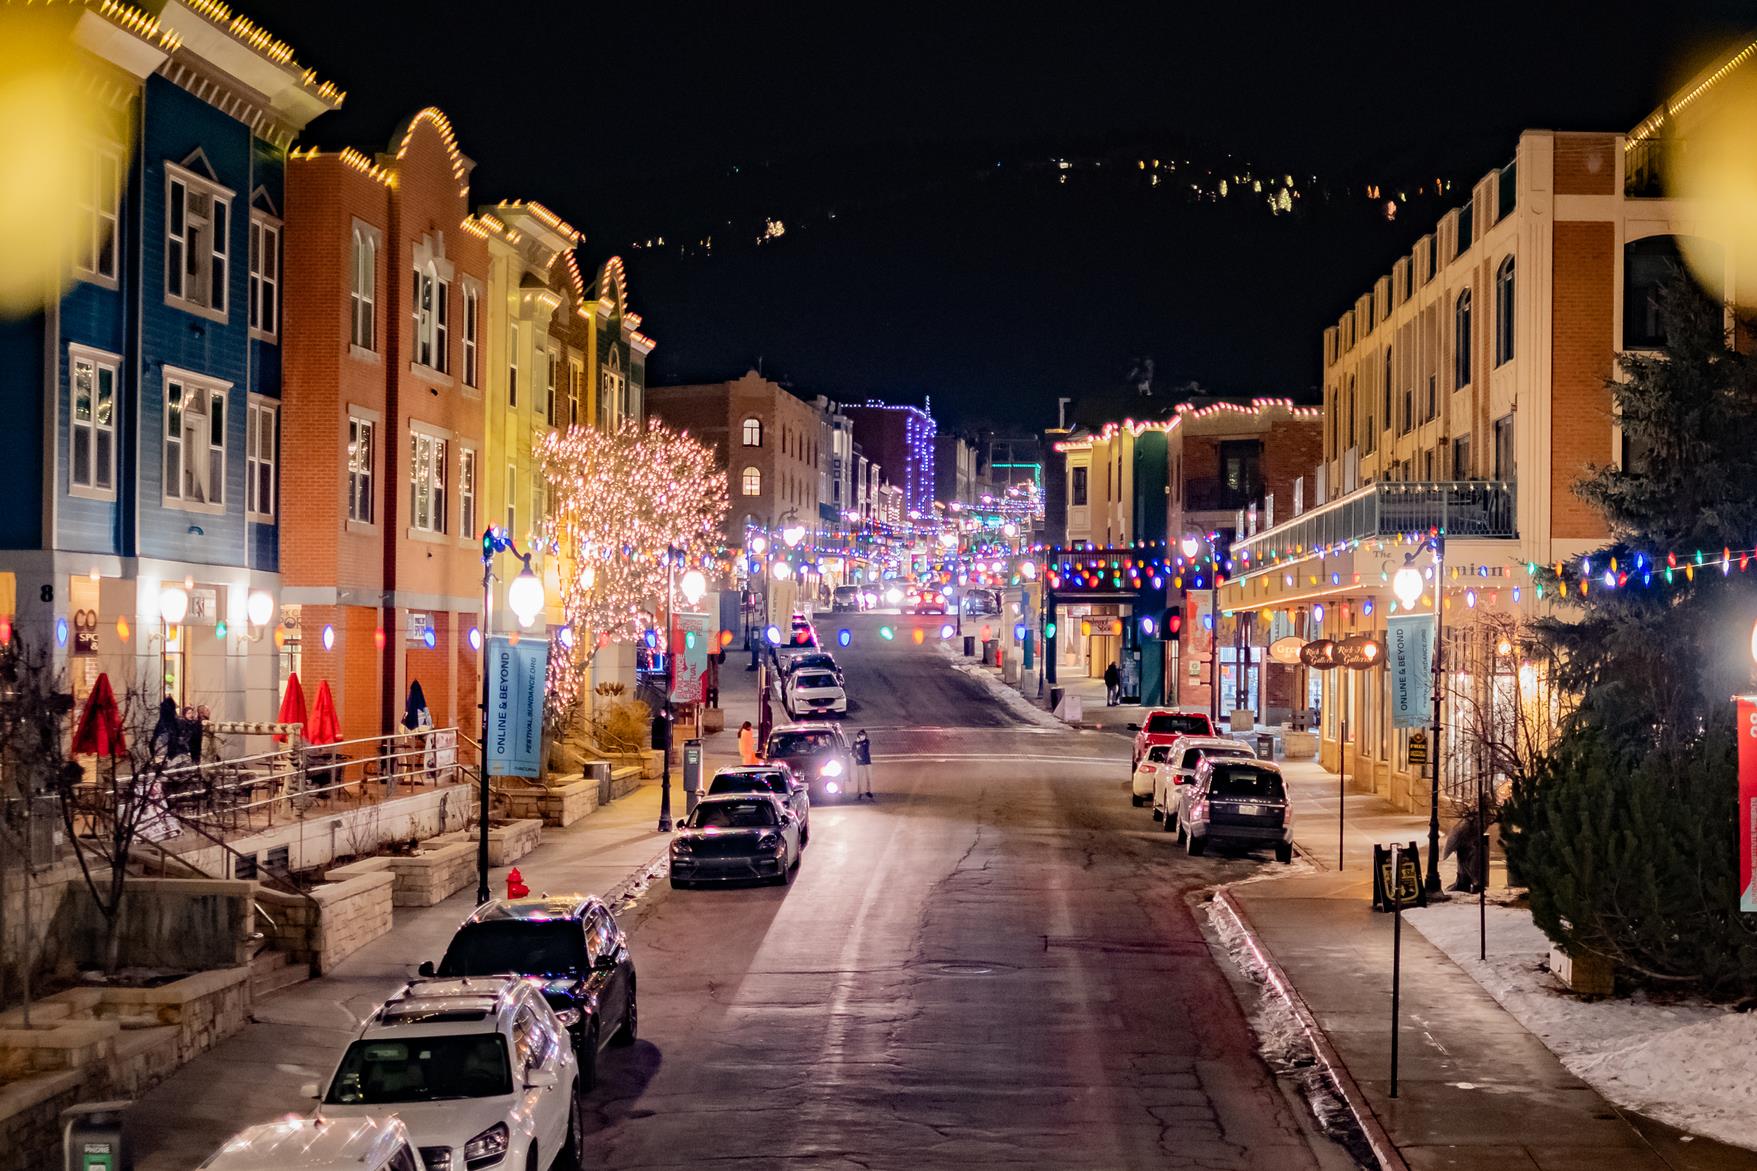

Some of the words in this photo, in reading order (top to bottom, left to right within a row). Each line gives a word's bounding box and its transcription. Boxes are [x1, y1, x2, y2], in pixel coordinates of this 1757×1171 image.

[1373, 550, 1391, 558] The
[41, 584, 53, 602] 8
[1396, 628, 1406, 668] BEYOND
[499, 652, 510, 701] BEYOND
[1400, 678, 1408, 711] ONLINE
[497, 711, 507, 755] ONLINE
